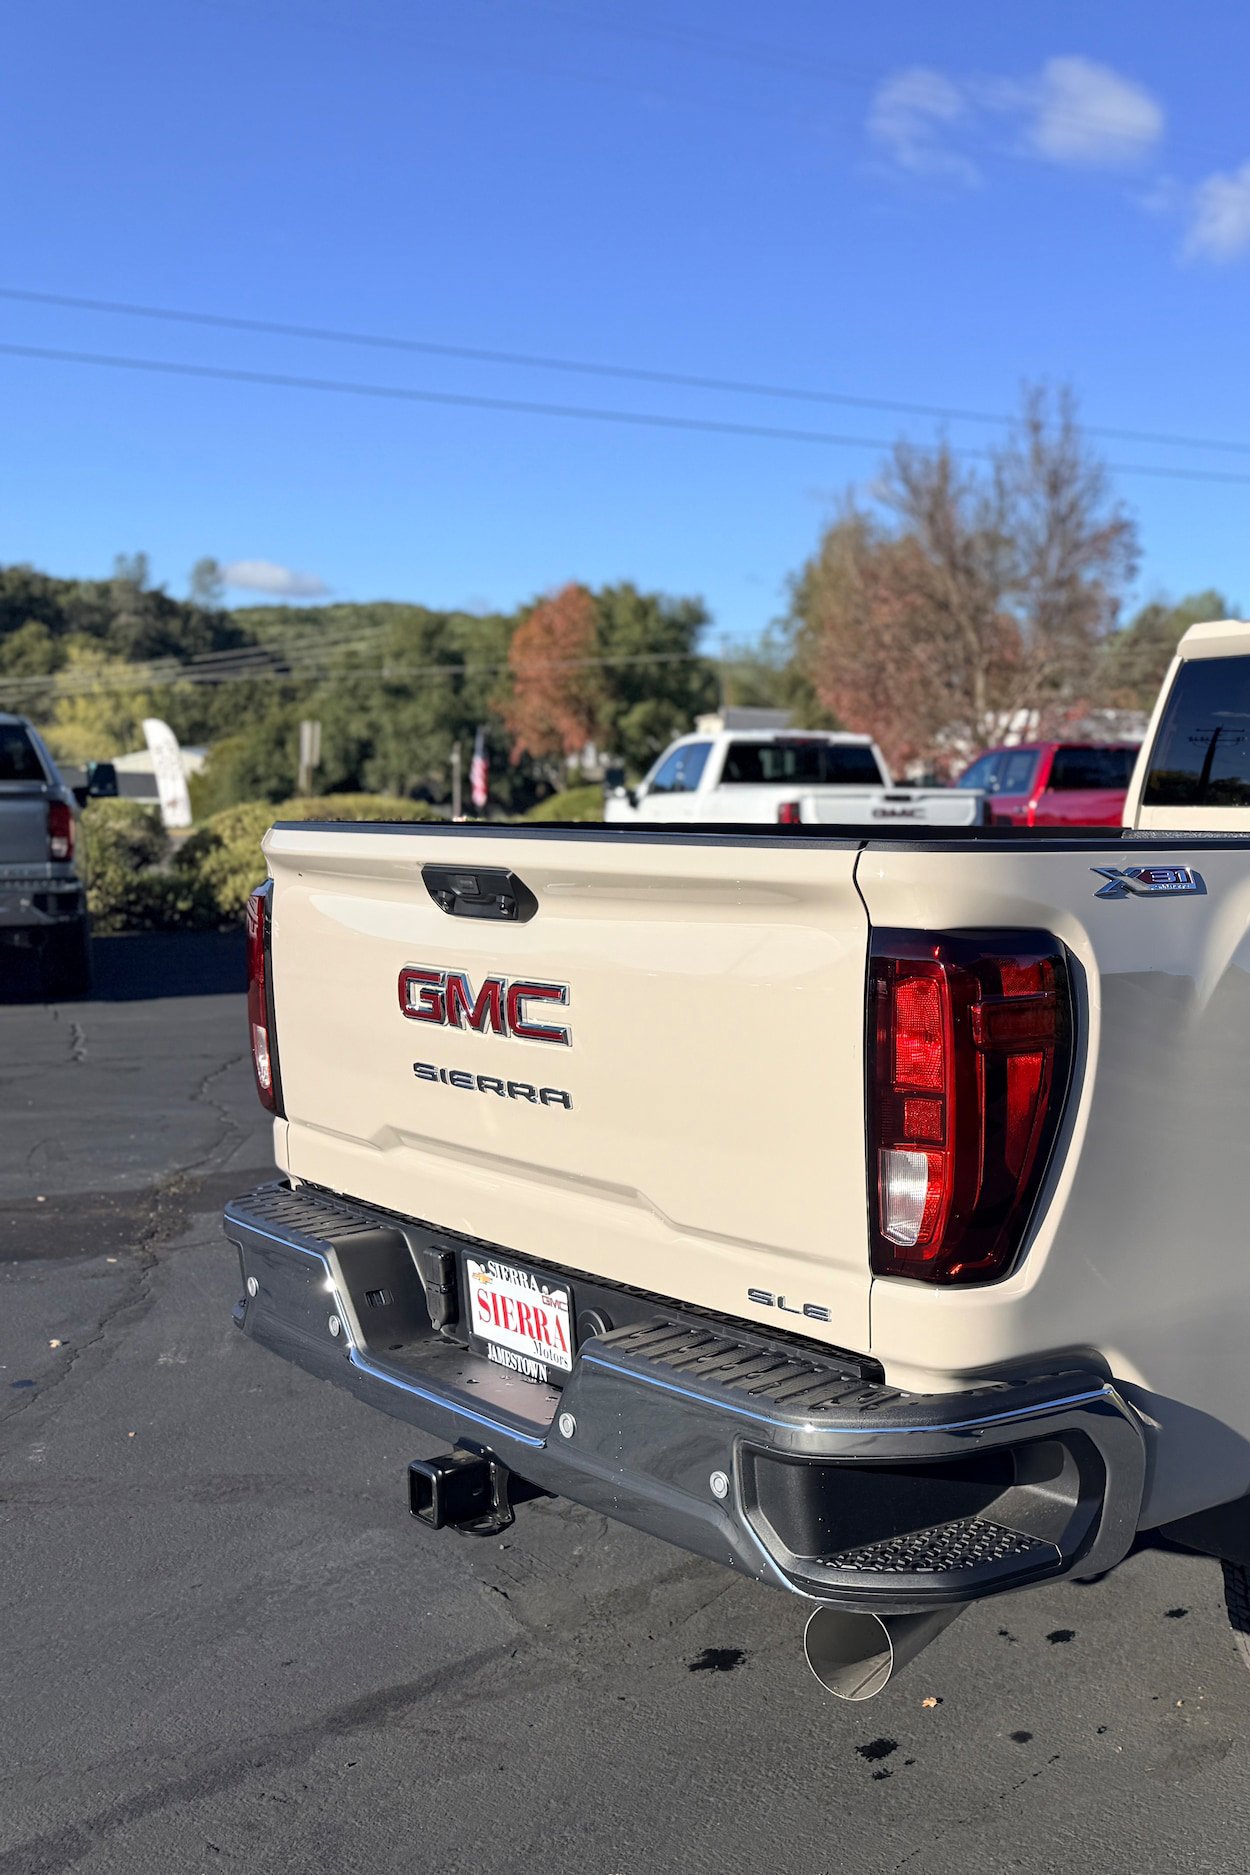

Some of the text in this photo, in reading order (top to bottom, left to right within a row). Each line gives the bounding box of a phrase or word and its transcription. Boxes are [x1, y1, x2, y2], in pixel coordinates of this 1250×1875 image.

[1088, 866, 1198, 896] X31
[398, 963, 573, 1047] GMC
[413, 1062, 574, 1110] SIERRA
[487, 1260, 541, 1293] SIERRA
[477, 1288, 568, 1353] SIERRA
[541, 1295, 569, 1312] GMC
[747, 1288, 833, 1322] SLE
[487, 1342, 549, 1382] JAMESTOWN
[533, 1340, 569, 1368] Motors
